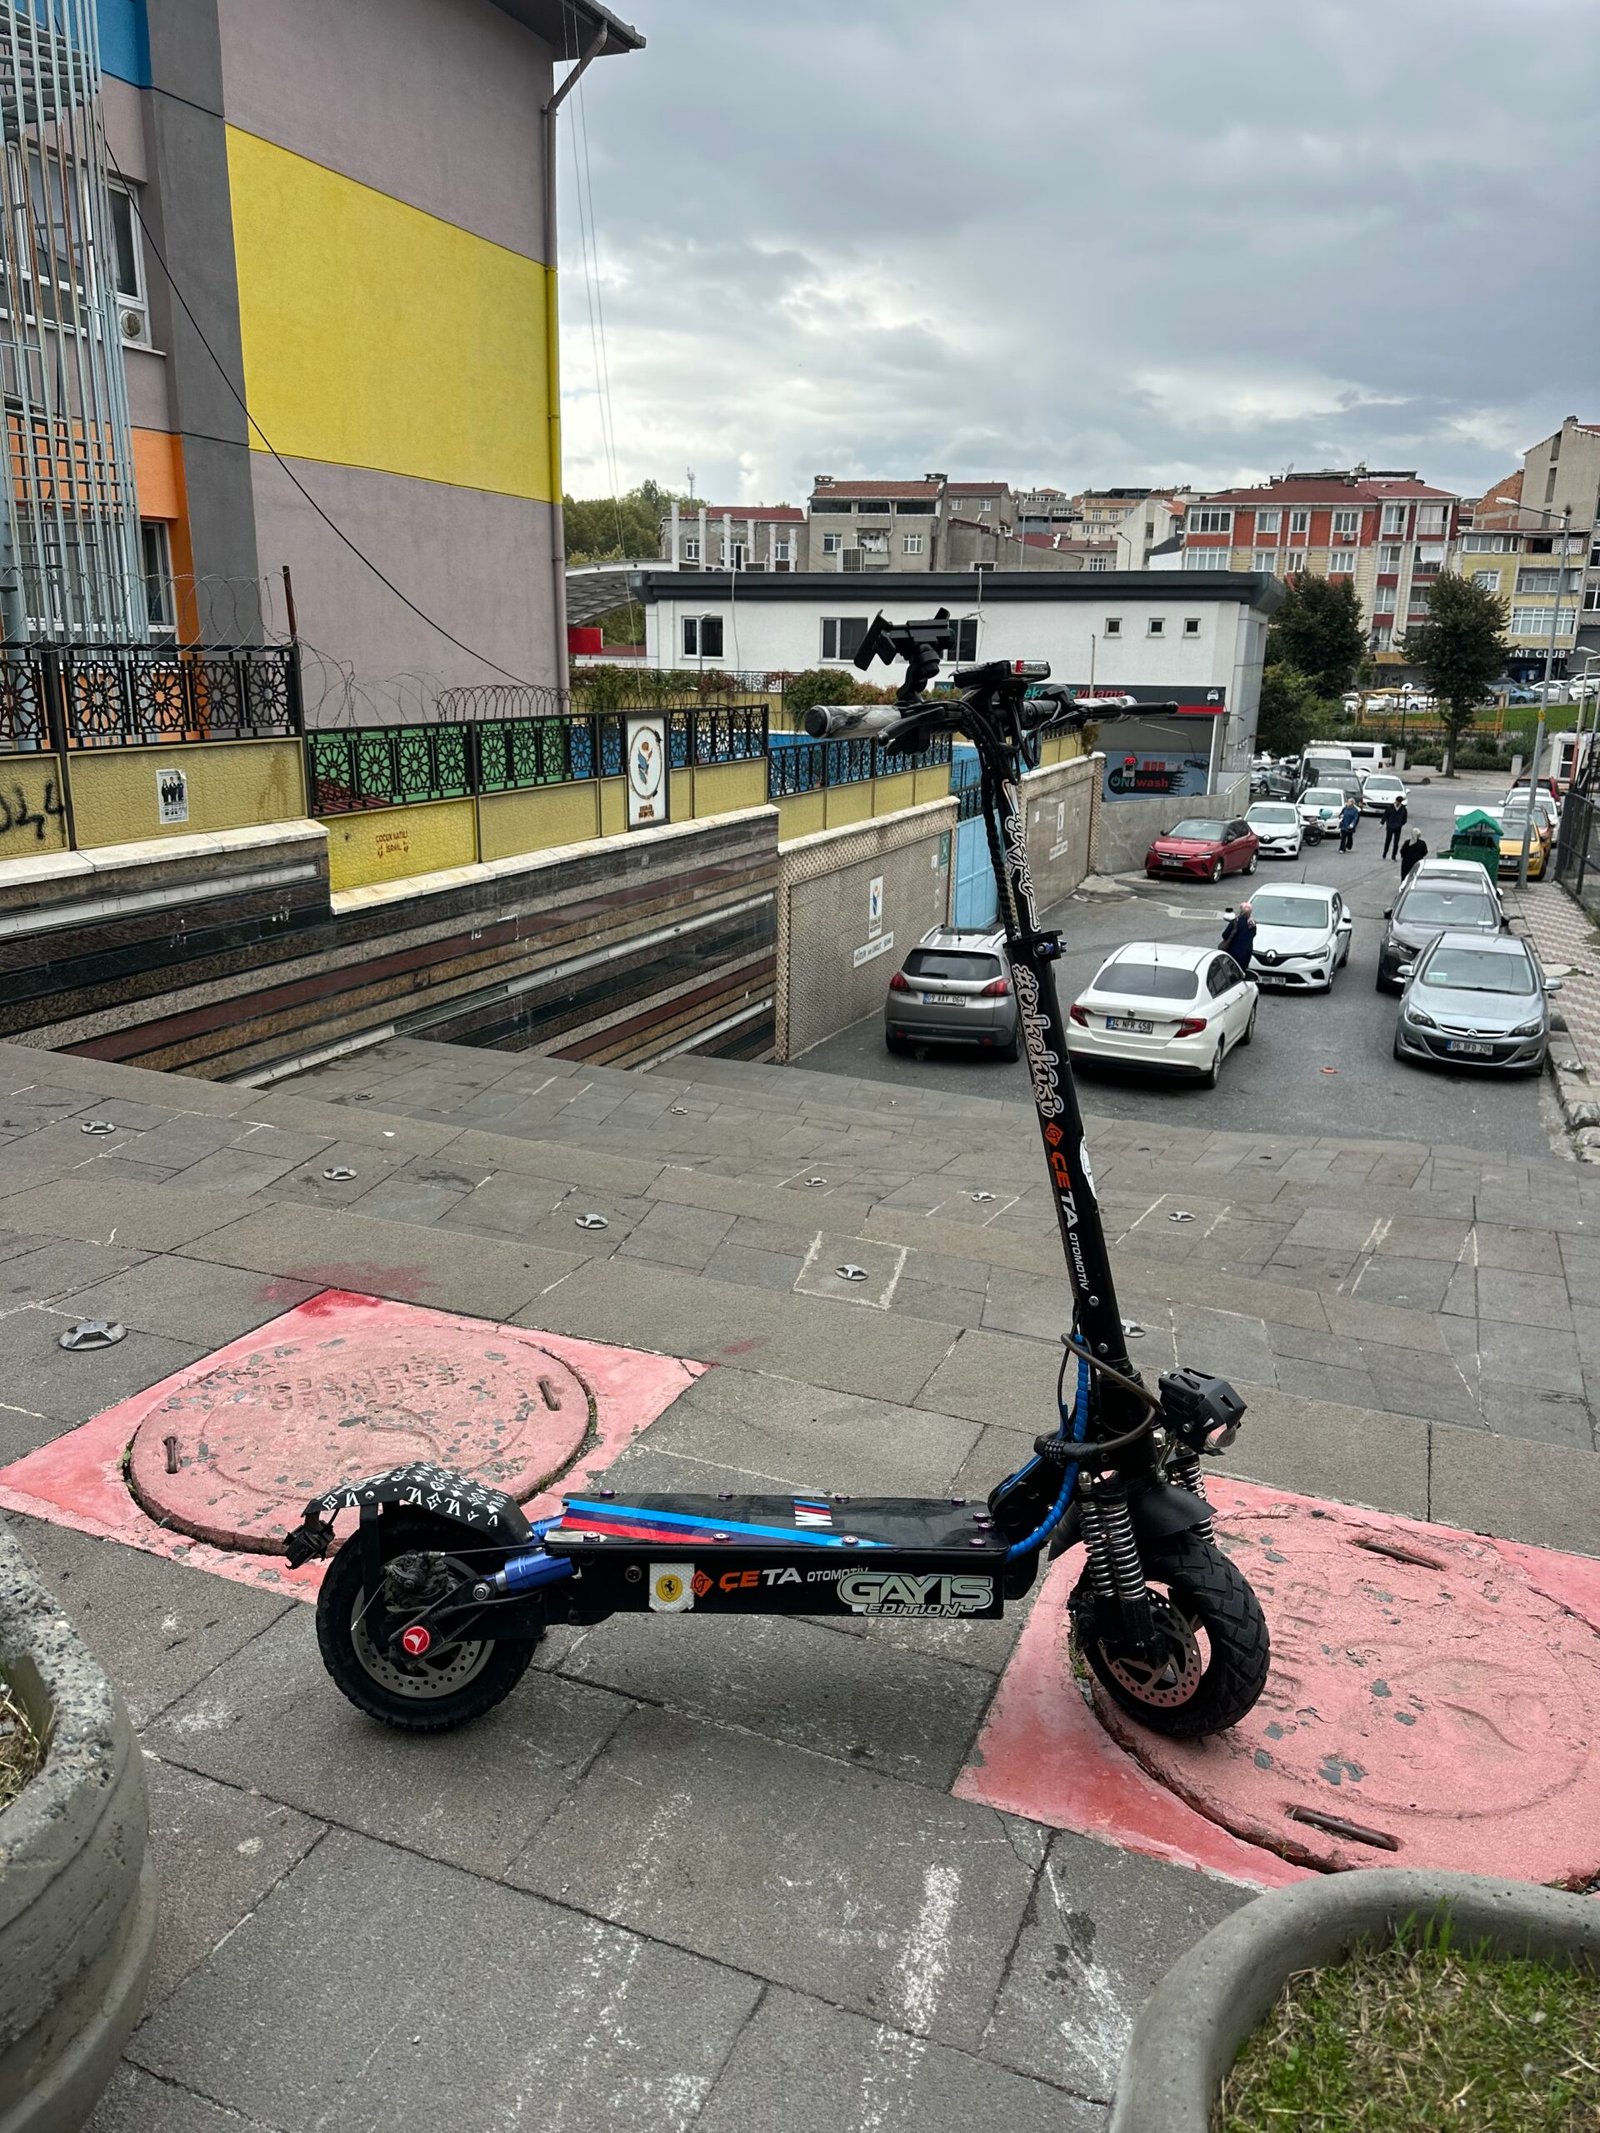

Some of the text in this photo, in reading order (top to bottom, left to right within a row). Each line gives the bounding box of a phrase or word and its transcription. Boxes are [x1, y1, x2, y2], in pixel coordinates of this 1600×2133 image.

[1050, 1151, 1090, 1291] ÇETA OTOMOTİV
[718, 1567, 802, 1593] ÇETA
